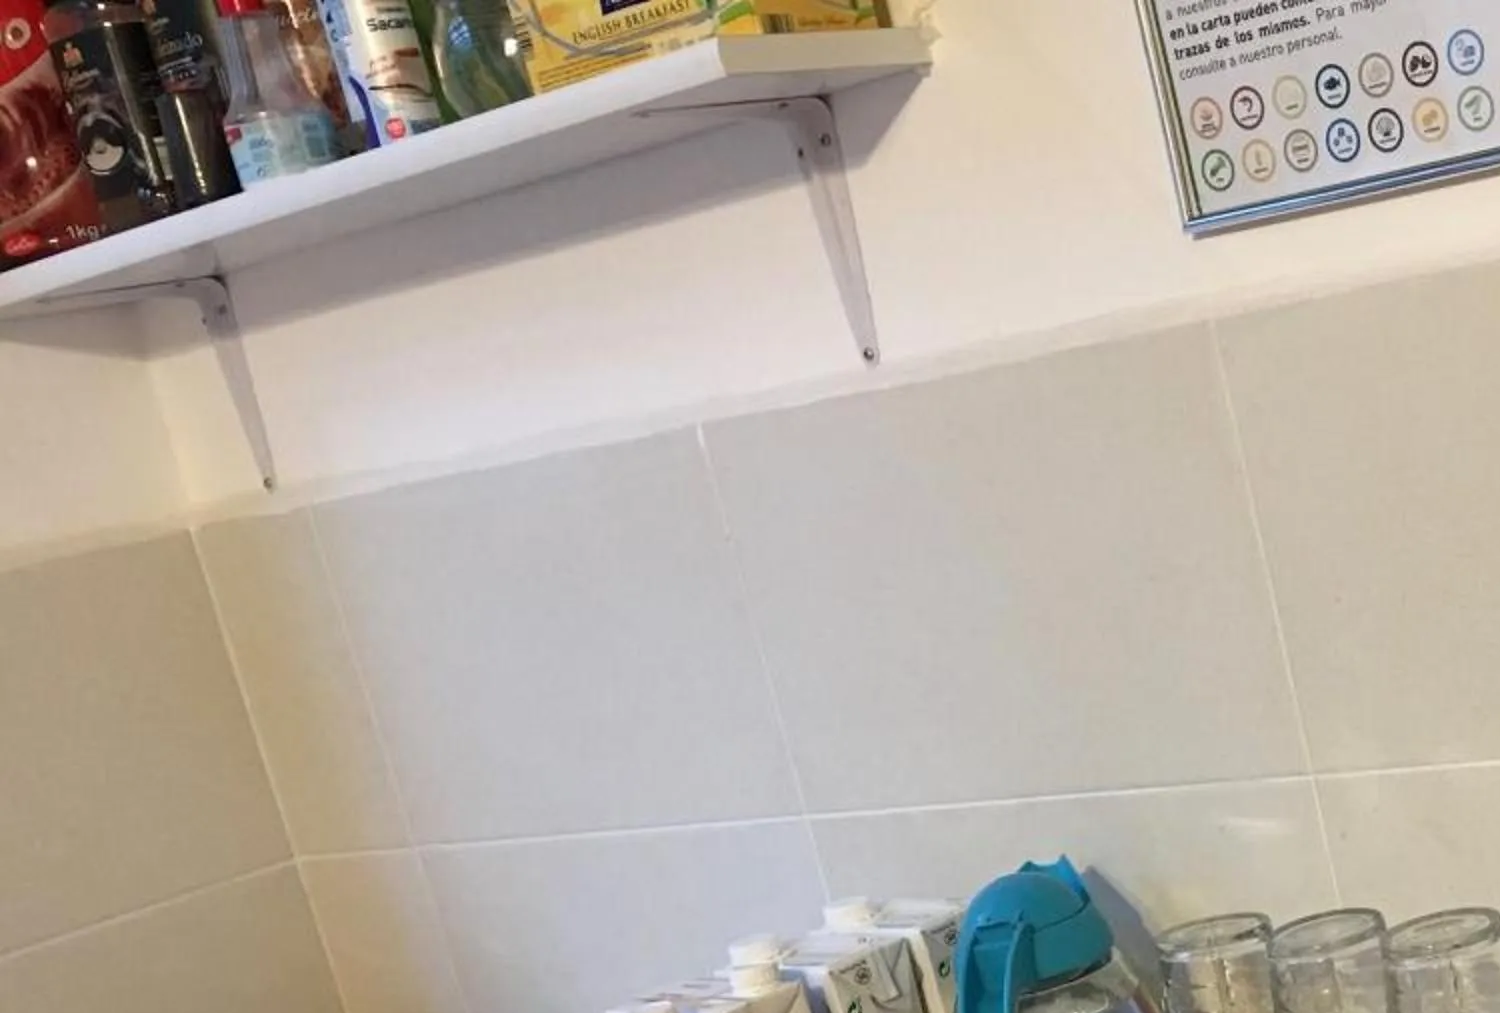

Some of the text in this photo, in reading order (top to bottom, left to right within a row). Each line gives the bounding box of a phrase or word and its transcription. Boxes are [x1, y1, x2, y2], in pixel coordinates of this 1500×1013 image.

[572, 0, 692, 46] ENGLISH BREAKFAST
[1170, 27, 1185, 40] en
[1185, 22, 1199, 35] la
[1201, 15, 1231, 31] carta
[1233, 1, 1279, 25] pueden
[1173, 40, 1211, 60] trazas
[1215, 35, 1230, 48] de
[1234, 29, 1253, 44] los
[1258, 15, 1312, 38] mismos.
[1315, 7, 1345, 22] Para
[1179, 55, 1227, 80] consulte
[1238, 42, 1285, 64] nuestro
[1286, 25, 1343, 56] personal.
